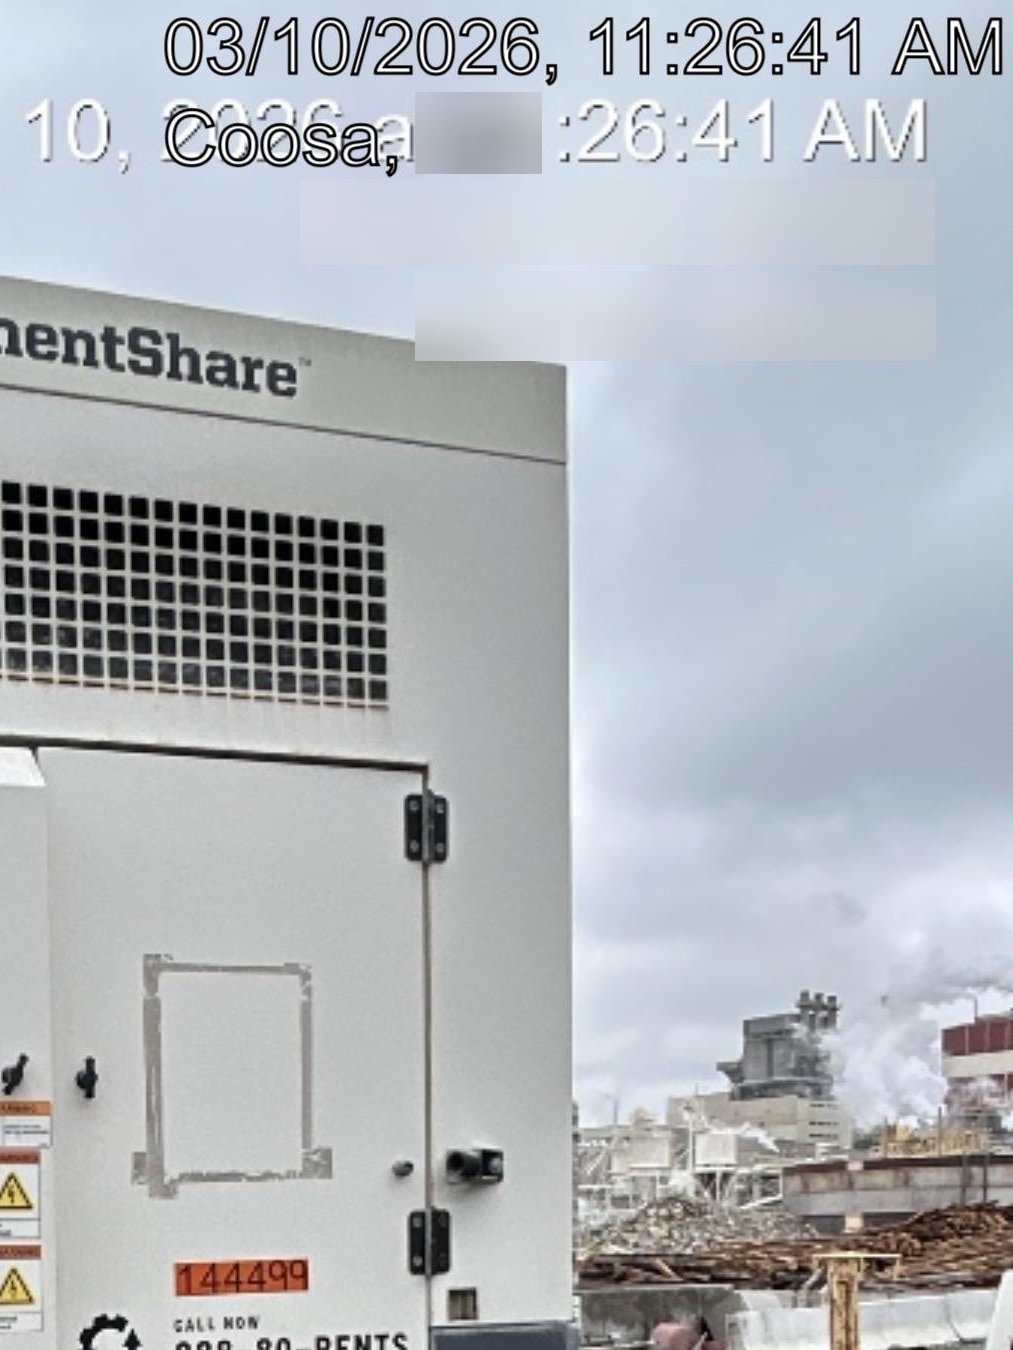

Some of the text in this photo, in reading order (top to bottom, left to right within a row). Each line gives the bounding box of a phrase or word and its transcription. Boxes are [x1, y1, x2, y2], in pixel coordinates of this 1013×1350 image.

[177, 1259, 308, 1294] 144499
[173, 1316, 261, 1333] CALL NOW
